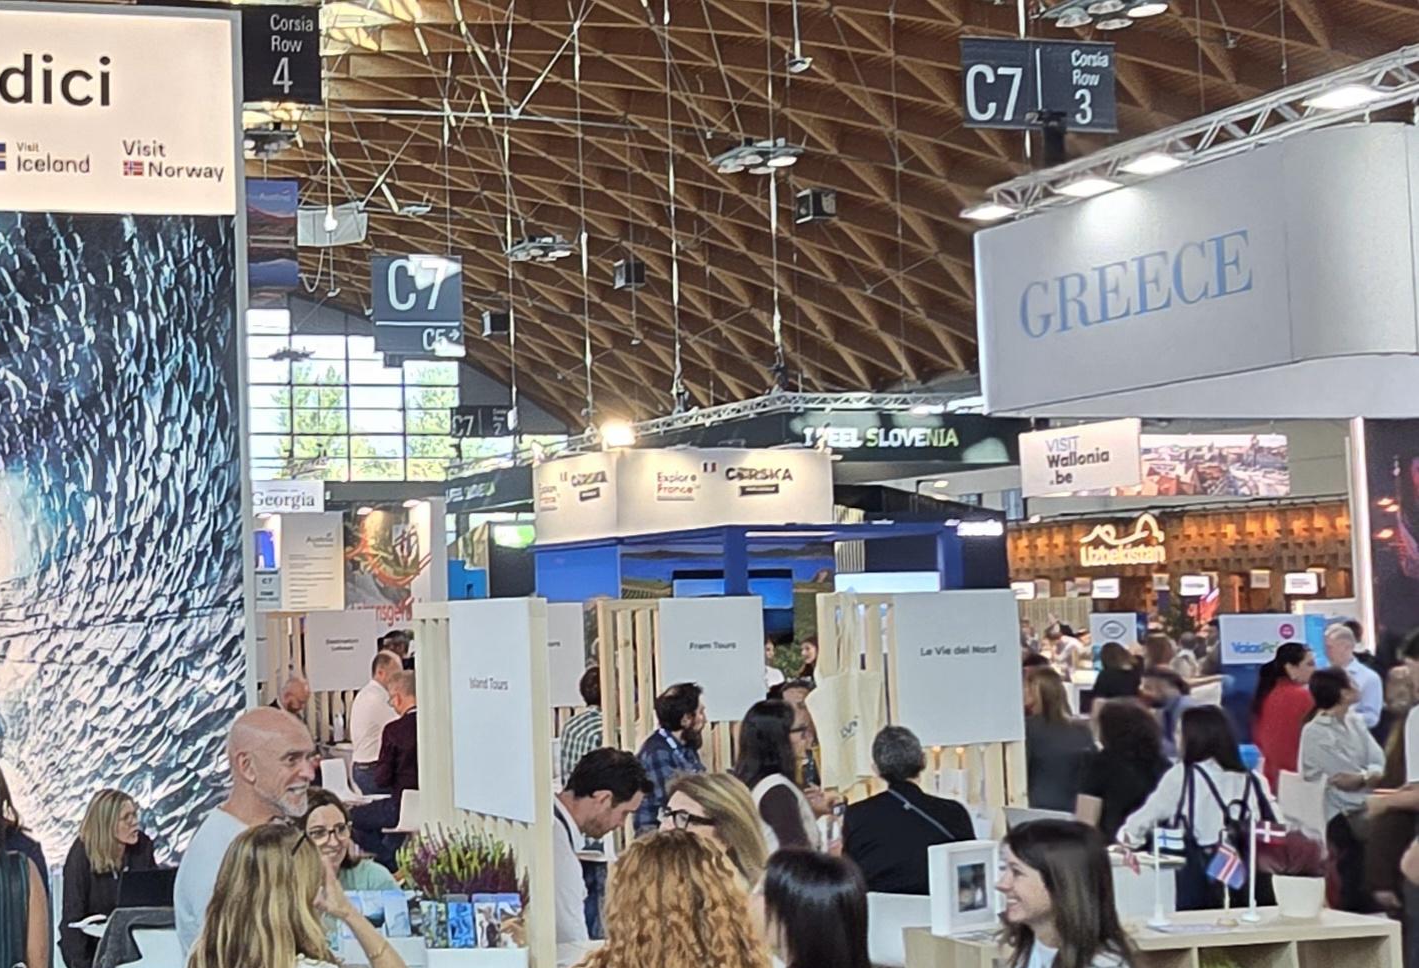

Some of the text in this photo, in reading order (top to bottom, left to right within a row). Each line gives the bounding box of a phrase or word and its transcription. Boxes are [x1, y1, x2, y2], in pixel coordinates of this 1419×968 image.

[270, 13, 314, 32] Corsia
[271, 35, 302, 52] Row
[1071, 49, 1109, 68] Corsia
[272, 57, 293, 94] 4
[1072, 69, 1100, 86] Row
[965, 63, 1023, 122] C7
[1074, 89, 1093, 124] 3
[16, 142, 39, 153] Visit
[122, 139, 166, 158] Visit
[16, 154, 90, 174] Iceland
[148, 161, 225, 183] Norway
[388, 259, 447, 311] C7
[1020, 229, 1253, 339] GREECE
[452, 414, 474, 436] C7
[865, 428, 959, 447] SLOVENIA
[1045, 436, 1080, 453] VISIT
[1046, 447, 1110, 468] Wallonia
[1049, 470, 1073, 485] .be
[253, 491, 316, 510] Georgia
[1080, 542, 1166, 567] Uzbekistan
